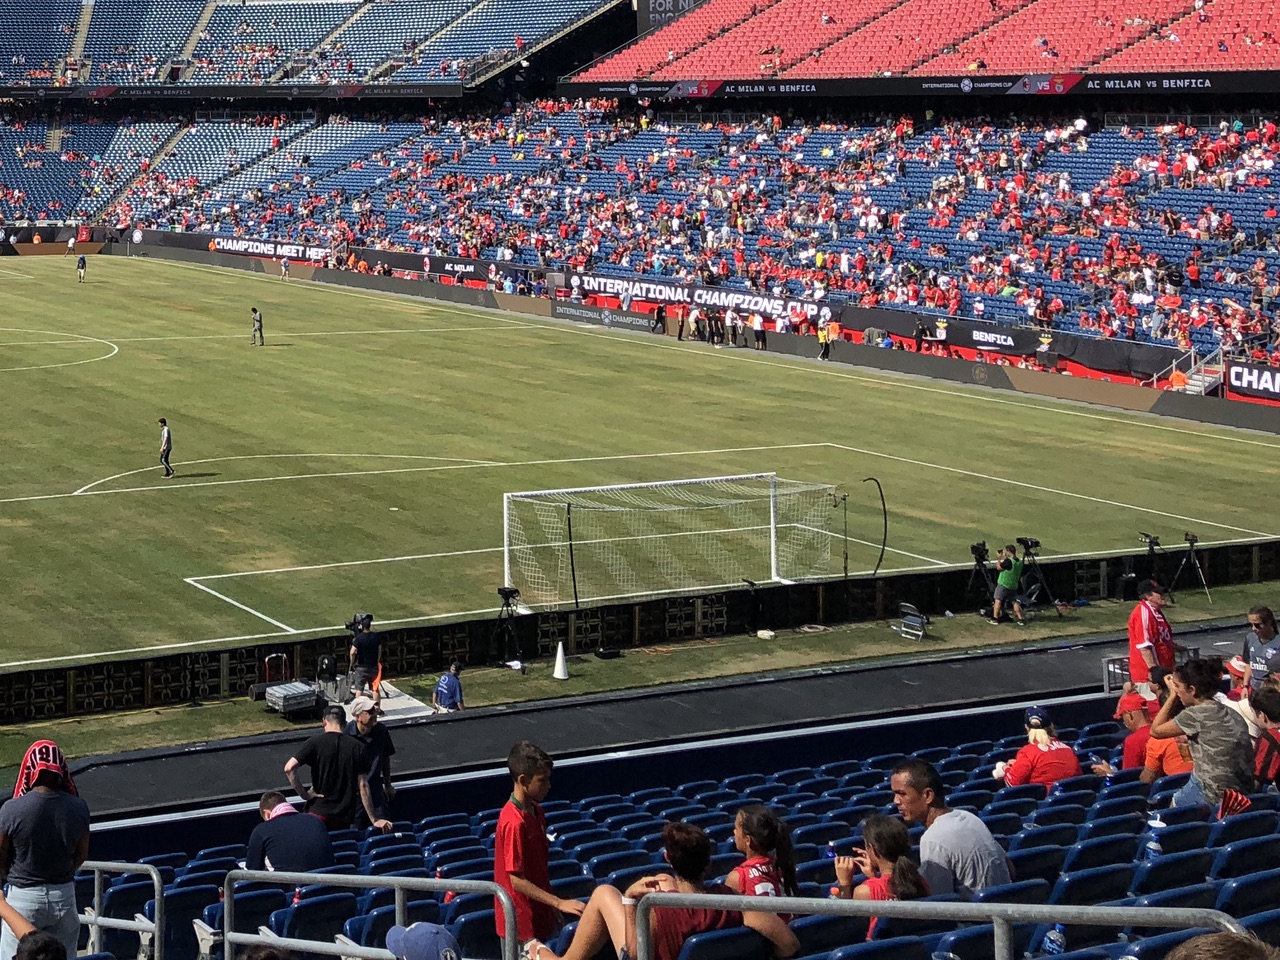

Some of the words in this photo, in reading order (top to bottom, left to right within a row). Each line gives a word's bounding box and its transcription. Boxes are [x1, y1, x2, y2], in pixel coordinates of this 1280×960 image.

[649, 0, 674, 12] FOR
[780, 84, 816, 92] BENFICA
[1037, 82, 1050, 90] VS
[1105, 80, 1141, 88] MILAN
[1163, 79, 1212, 88] BENFICA
[215, 238, 275, 255] CHAMPIONS
[276, 244, 305, 257] MEET
[445, 263, 453, 271] AC
[454, 264, 474, 272] MILAN
[582, 276, 690, 302] INTERNATIONAL
[694, 289, 784, 315] CHAMPIONS
[556, 306, 600, 319] INTERNATIONAL
[613, 314, 648, 326] CHAMPIONS
[972, 330, 1014, 346] BENFICA
